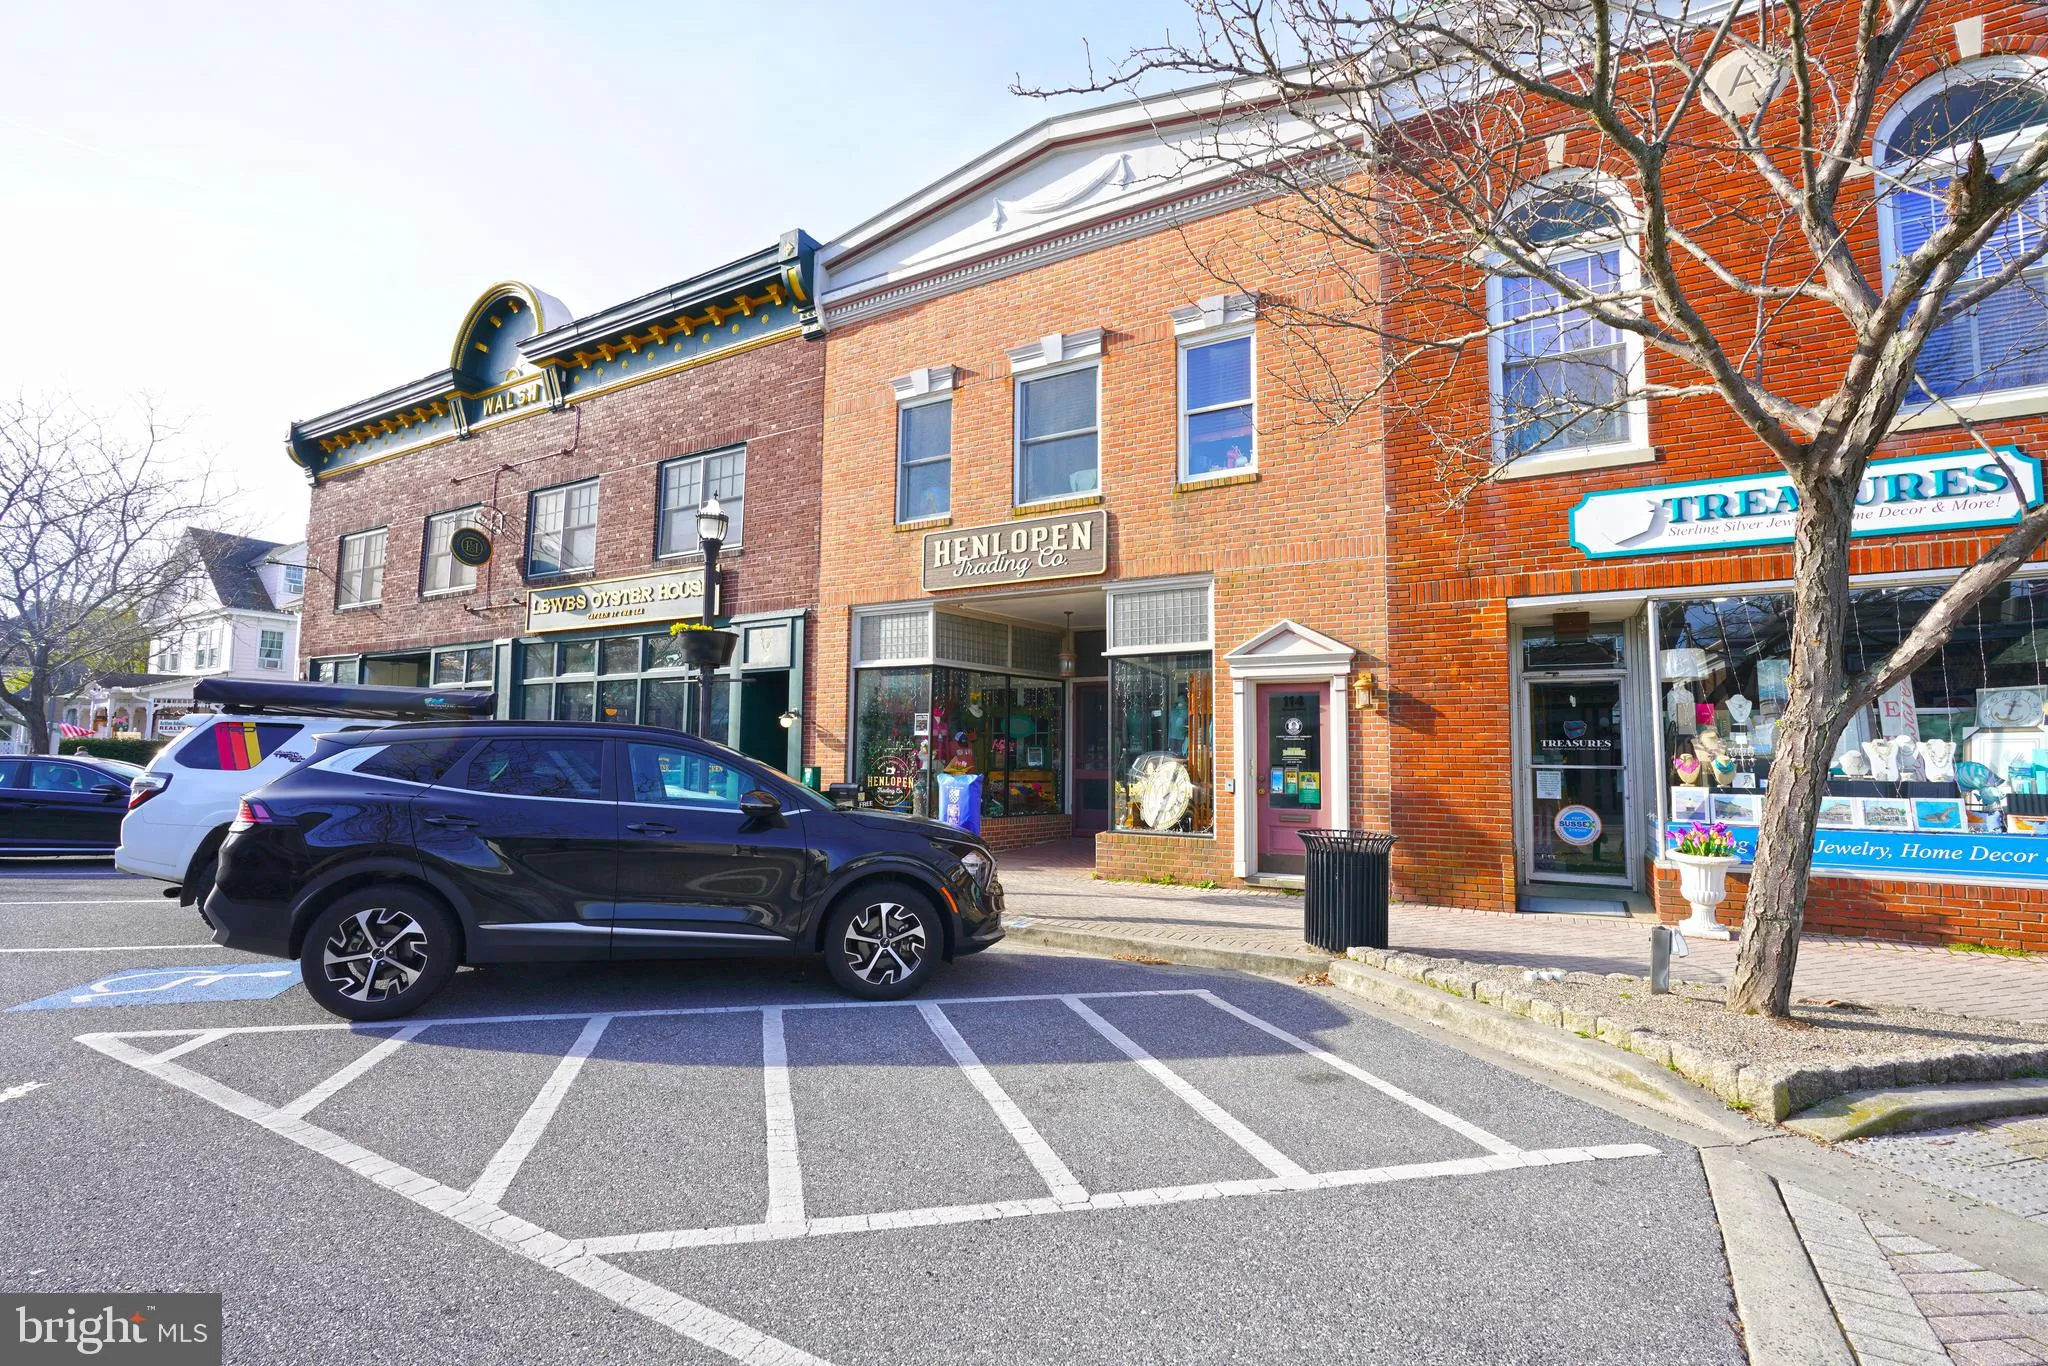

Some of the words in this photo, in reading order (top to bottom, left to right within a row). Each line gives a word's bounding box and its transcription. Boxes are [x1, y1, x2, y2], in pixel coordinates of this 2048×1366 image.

[1728, 64, 1762, 97] A
[483, 384, 541, 416] WALSH
[1662, 463, 2009, 523] TREAURES
[1668, 525, 1719, 537] Sterling
[1723, 520, 1764, 533] Silver
[1879, 505, 1926, 518] Decor
[1931, 500, 1945, 513] &
[1952, 496, 2001, 512] More!
[933, 520, 1093, 568] HENLOPEN
[952, 553, 1033, 577] Trading
[1037, 545, 1070, 568] Co.
[531, 595, 587, 615] LEWES
[591, 586, 655, 609] OYSTER
[1283, 695, 1305, 708] 114
[1540, 739, 1612, 747] TREASURES
[867, 774, 914, 789] HENLOPEN
[859, 800, 873, 808] FREE
[1559, 820, 1596, 829] SUSSEX
[1812, 839, 1893, 860] Jewelry,
[1900, 843, 1963, 860] Home
[1969, 845, 2039, 863] Decor
